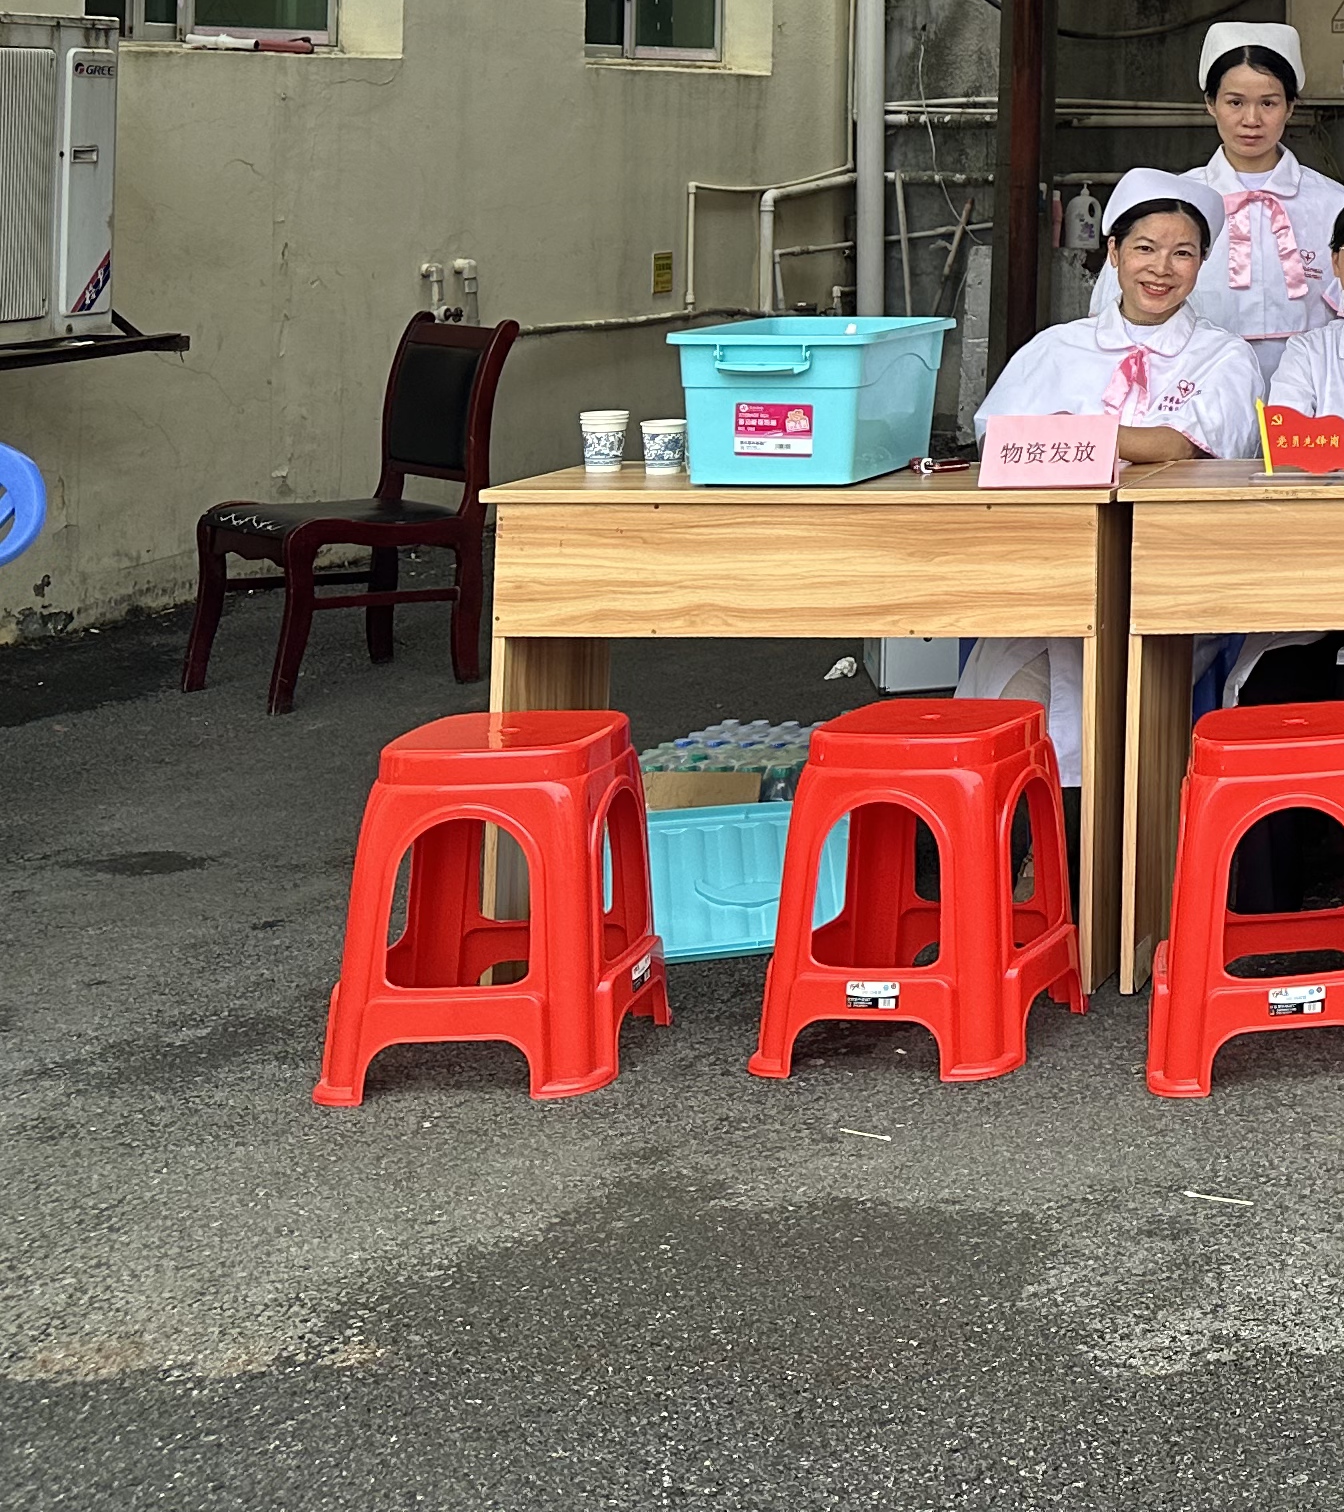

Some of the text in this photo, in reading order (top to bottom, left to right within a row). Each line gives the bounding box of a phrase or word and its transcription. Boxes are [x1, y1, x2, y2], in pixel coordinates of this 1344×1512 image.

[1276, 434, 1340, 449] 党员先锋岗
[1000, 440, 1096, 465] 物资发放
